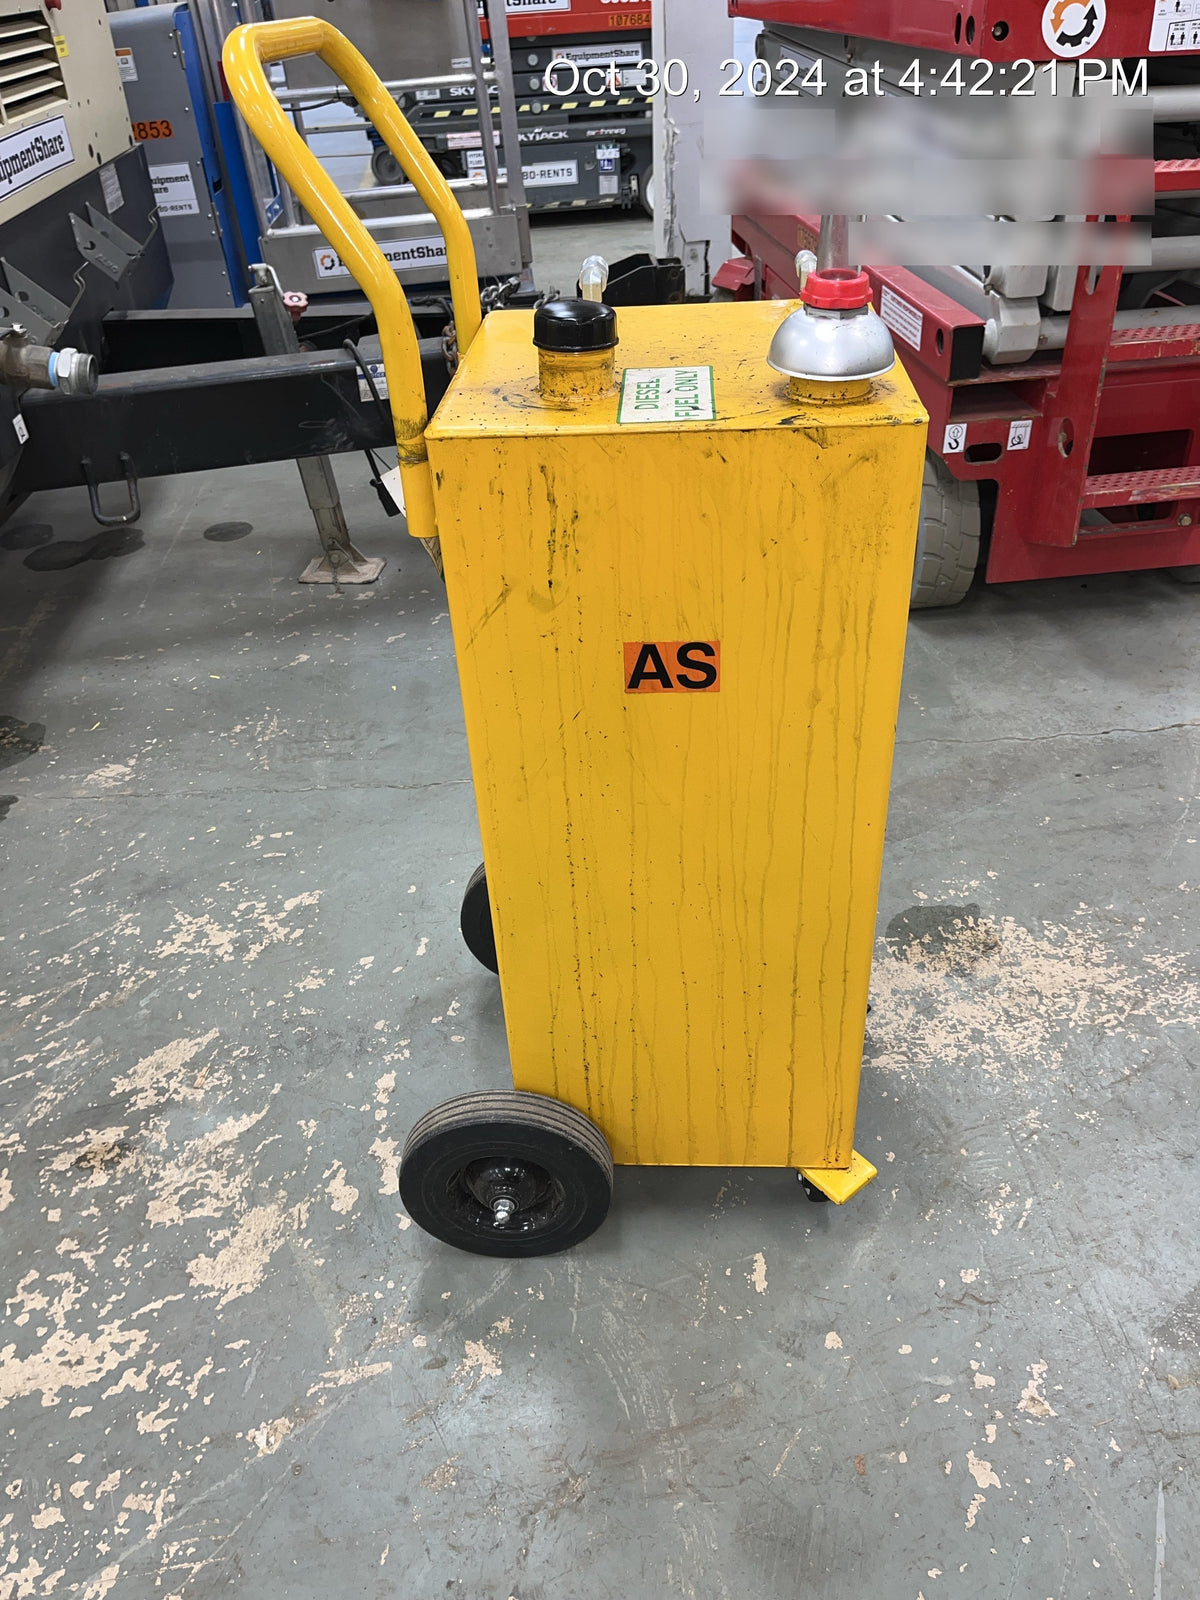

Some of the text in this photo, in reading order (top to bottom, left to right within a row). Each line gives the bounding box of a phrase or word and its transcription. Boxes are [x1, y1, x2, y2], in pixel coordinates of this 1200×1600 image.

[565, 49, 640, 61] EquipmentShare
[136, 119, 173, 140] 853
[151, 174, 190, 186] uipment
[634, 378, 660, 410] DIESEL
[674, 369, 700, 418] FUEL ONLY
[627, 642, 717, 689] AS
